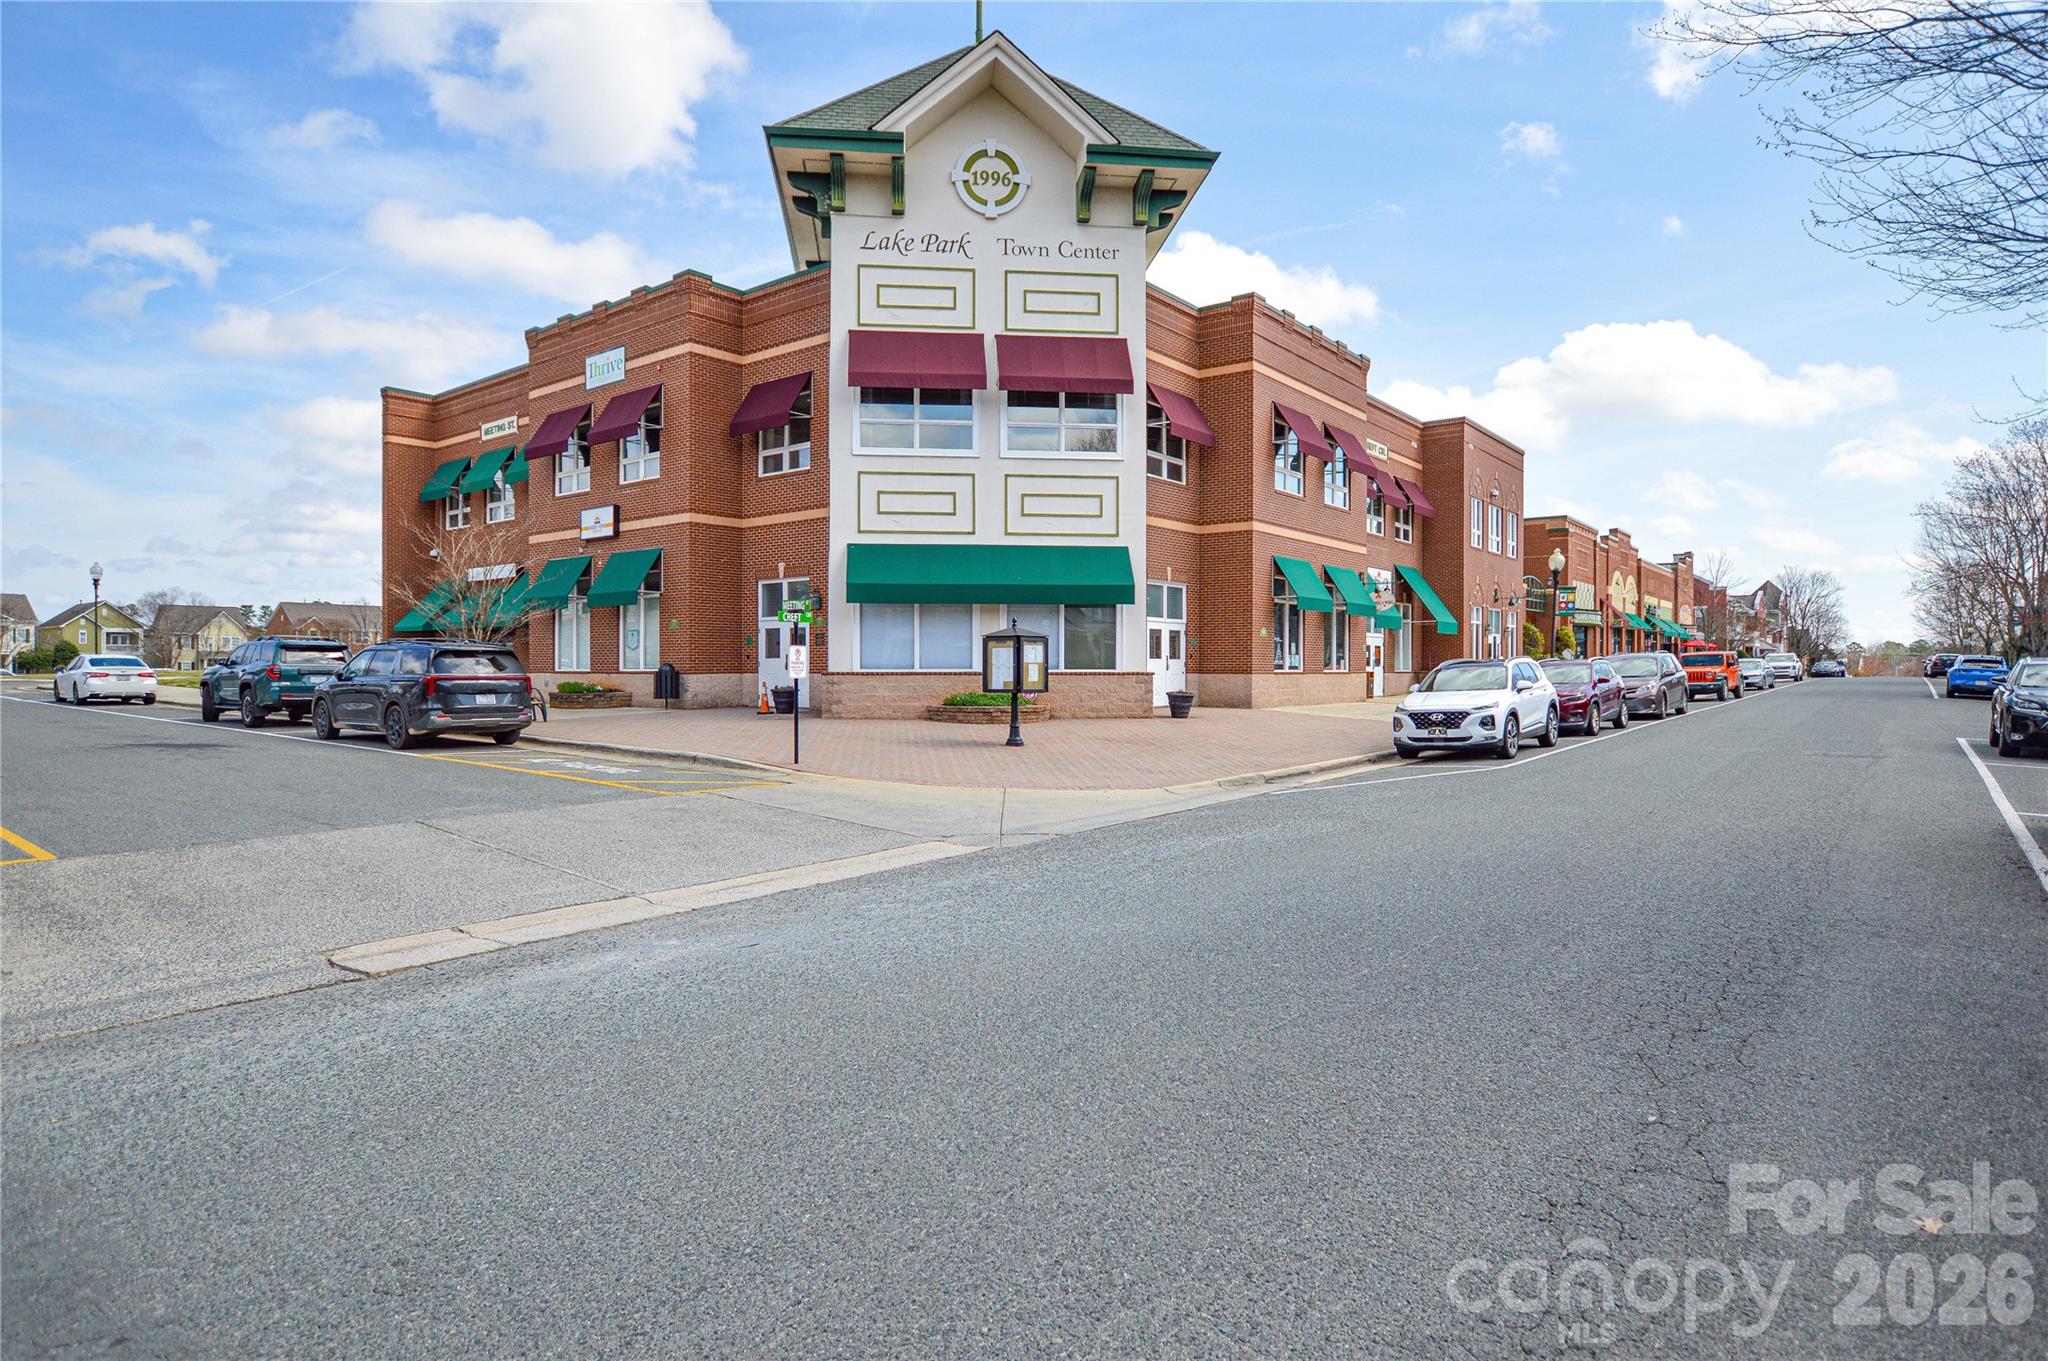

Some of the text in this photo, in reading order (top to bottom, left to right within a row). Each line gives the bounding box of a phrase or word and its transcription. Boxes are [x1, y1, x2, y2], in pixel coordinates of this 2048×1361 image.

[971, 169, 1012, 187] 1996
[860, 229, 1120, 261] Lake Park Town Center
[588, 357, 623, 379] Thrive
